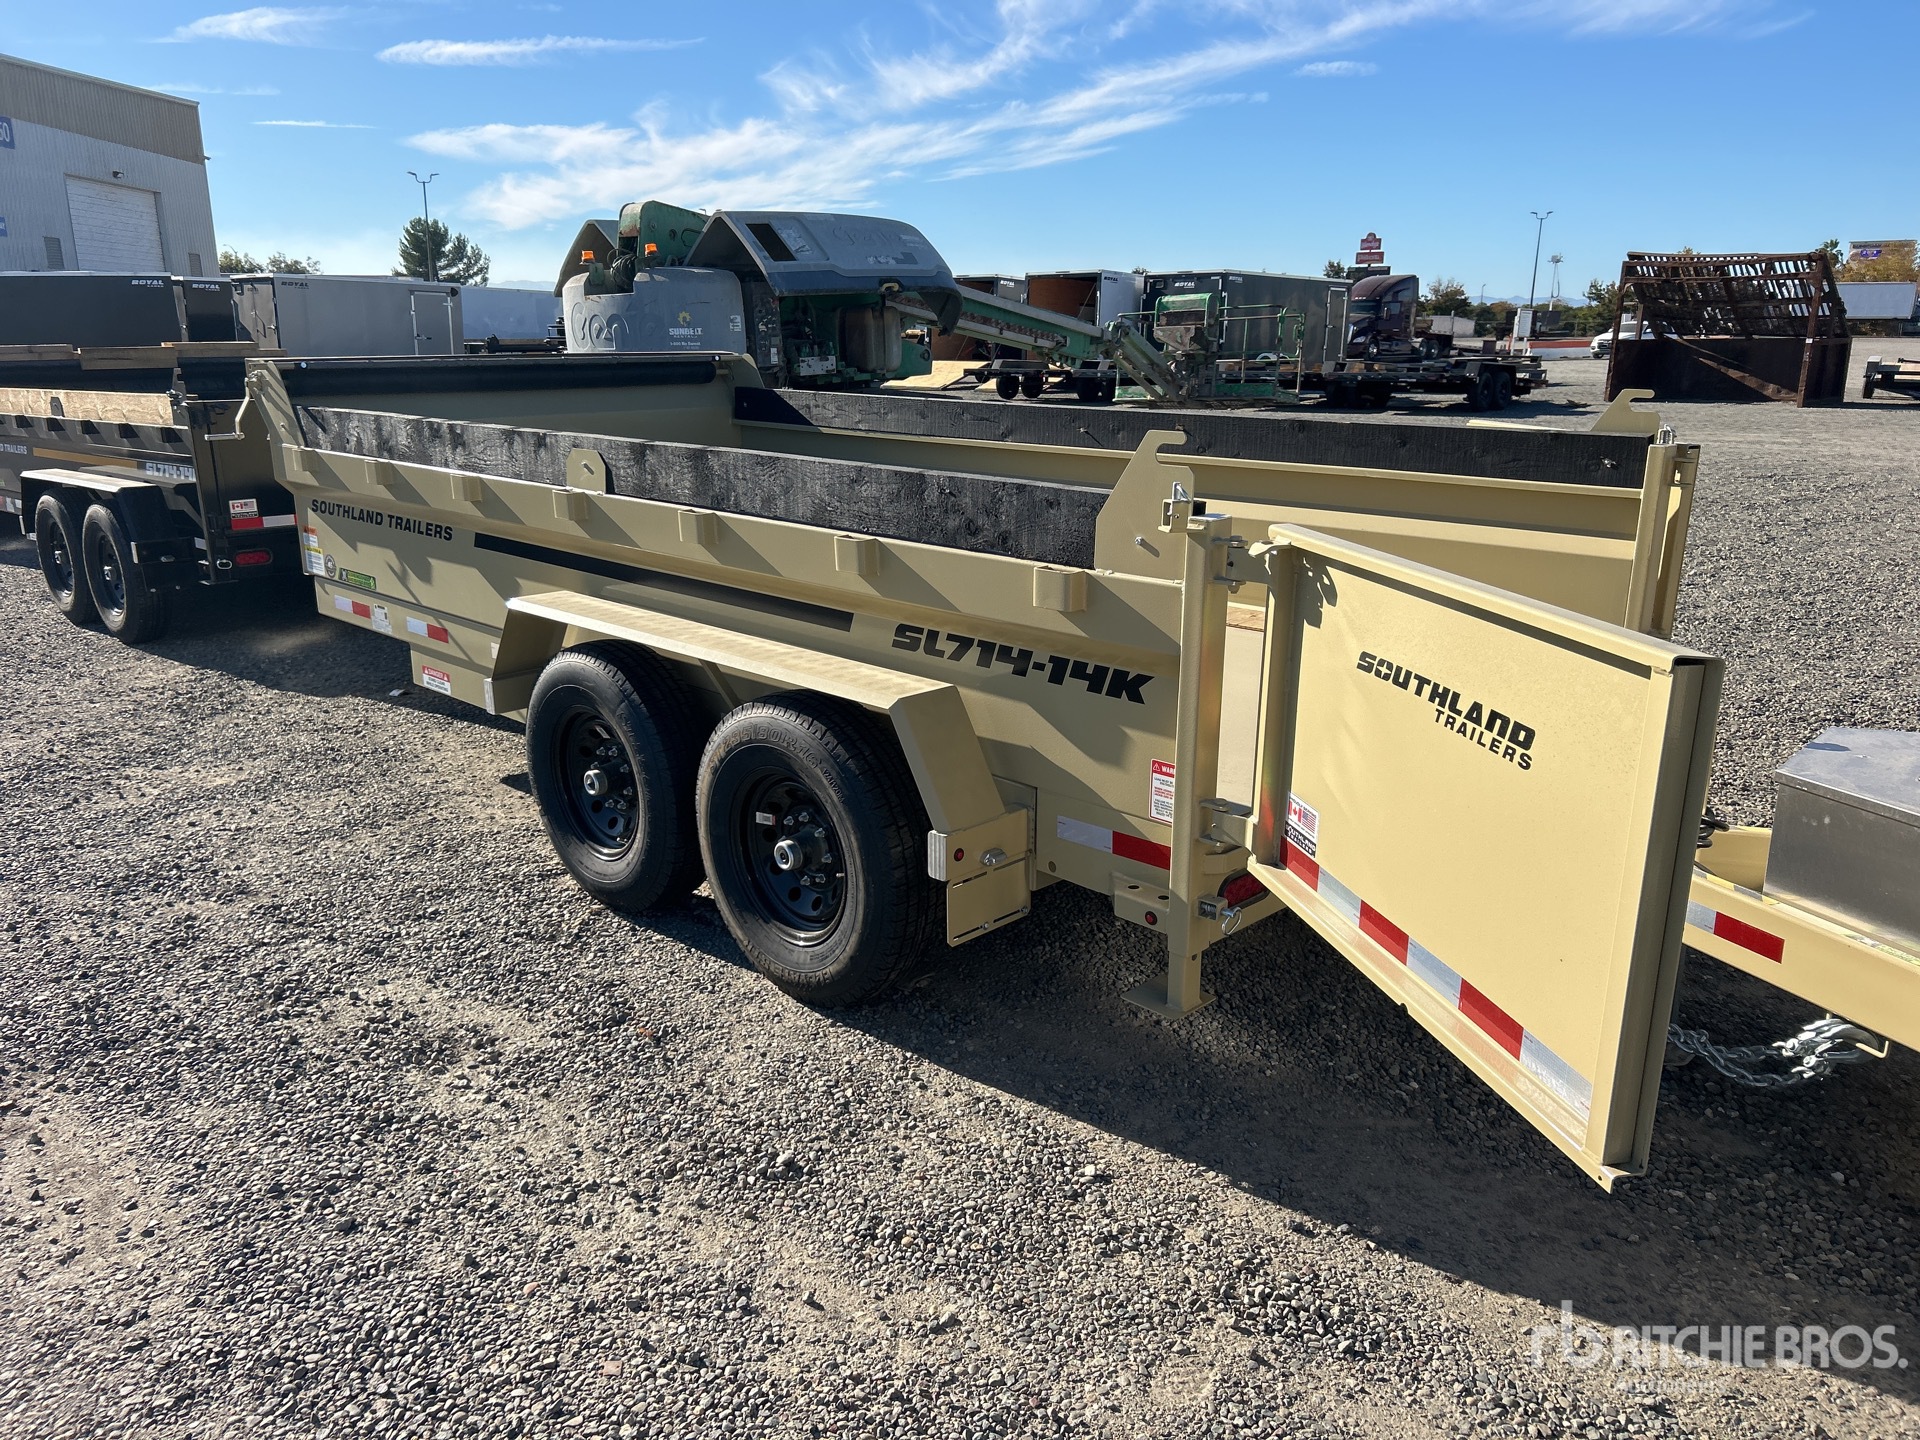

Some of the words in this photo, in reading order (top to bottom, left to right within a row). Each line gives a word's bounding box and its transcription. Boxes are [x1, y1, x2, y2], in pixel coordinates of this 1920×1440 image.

[668, 327, 703, 336] SUNBELT
[4, 444, 28, 455] TRAILERS
[311, 499, 384, 526] SOUTHLAND
[387, 514, 454, 541] TRAILERS
[891, 623, 1155, 705] SL714-14K
[1356, 650, 1536, 752] SOUTHLAND
[1435, 708, 1533, 771] TRAILERS
